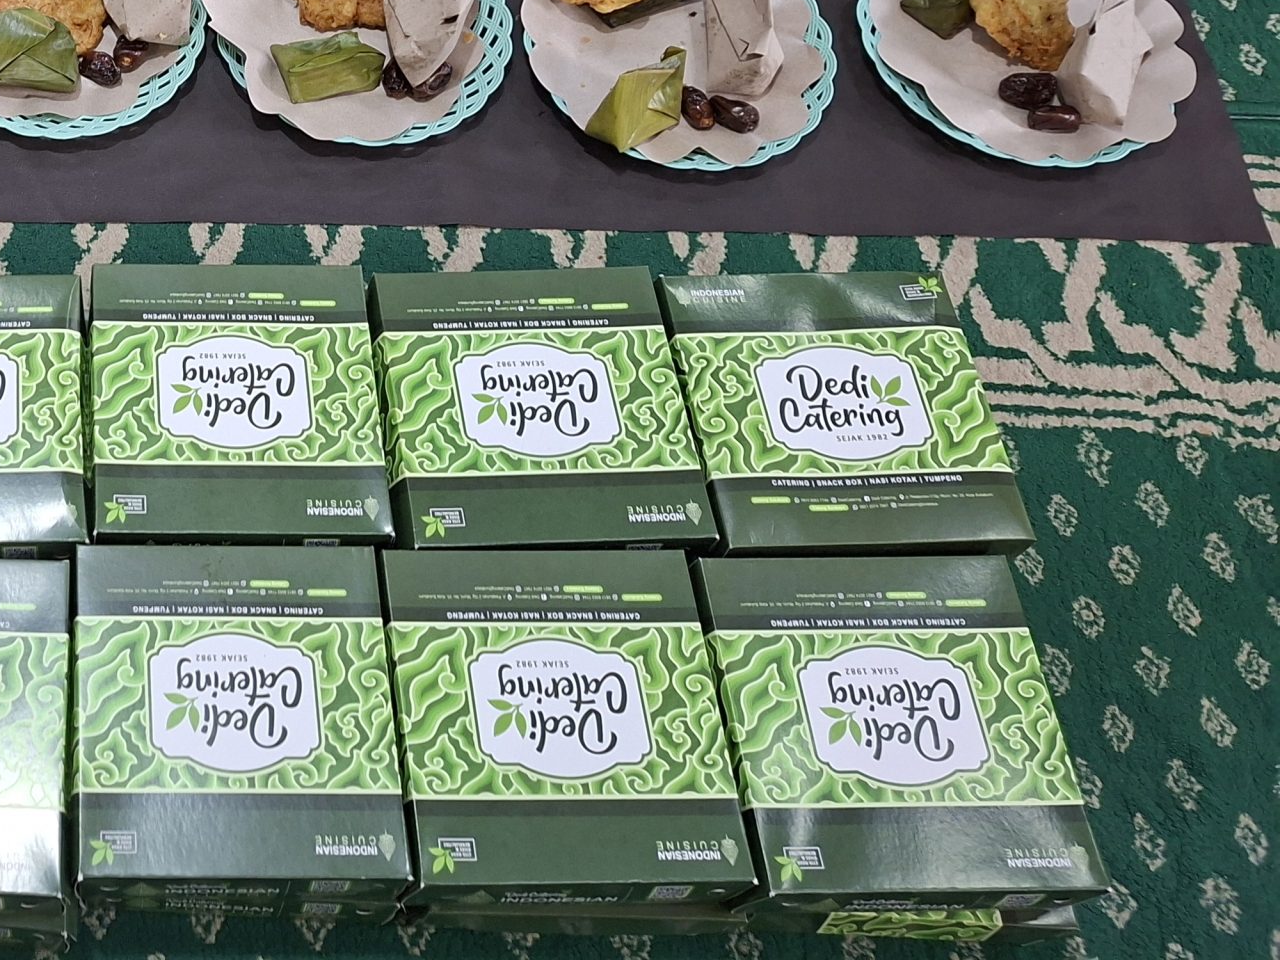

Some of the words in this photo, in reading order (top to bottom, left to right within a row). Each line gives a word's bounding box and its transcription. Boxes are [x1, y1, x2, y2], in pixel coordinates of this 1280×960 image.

[692, 289, 746, 298] INDONESIAN
[693, 296, 748, 304] CUISINE
[499, 320, 518, 328] NASI
[541, 319, 566, 327] SNACK
[182, 356, 296, 397] Catering
[480, 364, 598, 403] Catering
[786, 364, 869, 402] Dedi
[203, 392, 282, 430] Dedi
[510, 399, 590, 437] Dedi
[779, 397, 904, 437] Catering
[771, 479, 811, 487] CATERING
[817, 478, 845, 486] SNACK
[846, 477, 864, 485] BOX
[869, 477, 890, 485] NASI
[890, 476, 918, 484] KOTAK
[924, 475, 964, 483] TUMPENG
[306, 499, 362, 507] CUISINE
[307, 507, 363, 516] INDONESIAN
[626, 504, 684, 513] CUISINE
[628, 512, 686, 522] INDONESIAN
[132, 605, 170, 613] TUMPENG
[177, 606, 203, 614] KOTAK
[205, 606, 224, 614] NASI
[231, 606, 248, 614] BOX
[250, 606, 277, 614] SNACK
[284, 607, 323, 615] CATERING
[547, 612, 564, 620] BOX
[566, 612, 593, 620] SNACK
[600, 612, 640, 620] CATERING
[769, 619, 810, 627] TUMPENG
[815, 619, 844, 627] KOTAK
[844, 618, 865, 627] NASI
[871, 619, 889, 627] BOX
[890, 618, 919, 626] SNACK
[925, 618, 967, 626] CATERING
[195, 654, 217, 662] 1982
[515, 660, 538, 668] 1982
[844, 667, 867, 675] 1982
[176, 658, 303, 709] Catering
[498, 664, 627, 714] Catering
[828, 671, 961, 721] Catering
[200, 702, 287, 749] Dedi
[529, 708, 617, 755] Dedi
[864, 715, 955, 762] Dedi
[315, 835, 376, 844] CUISINE
[315, 844, 377, 855] INDONESIAN
[656, 840, 719, 850] CUISINE
[657, 850, 721, 860] INDONESIAN
[1003, 847, 1068, 857] CUISINE
[1006, 857, 1071, 868] INDONESIAN
